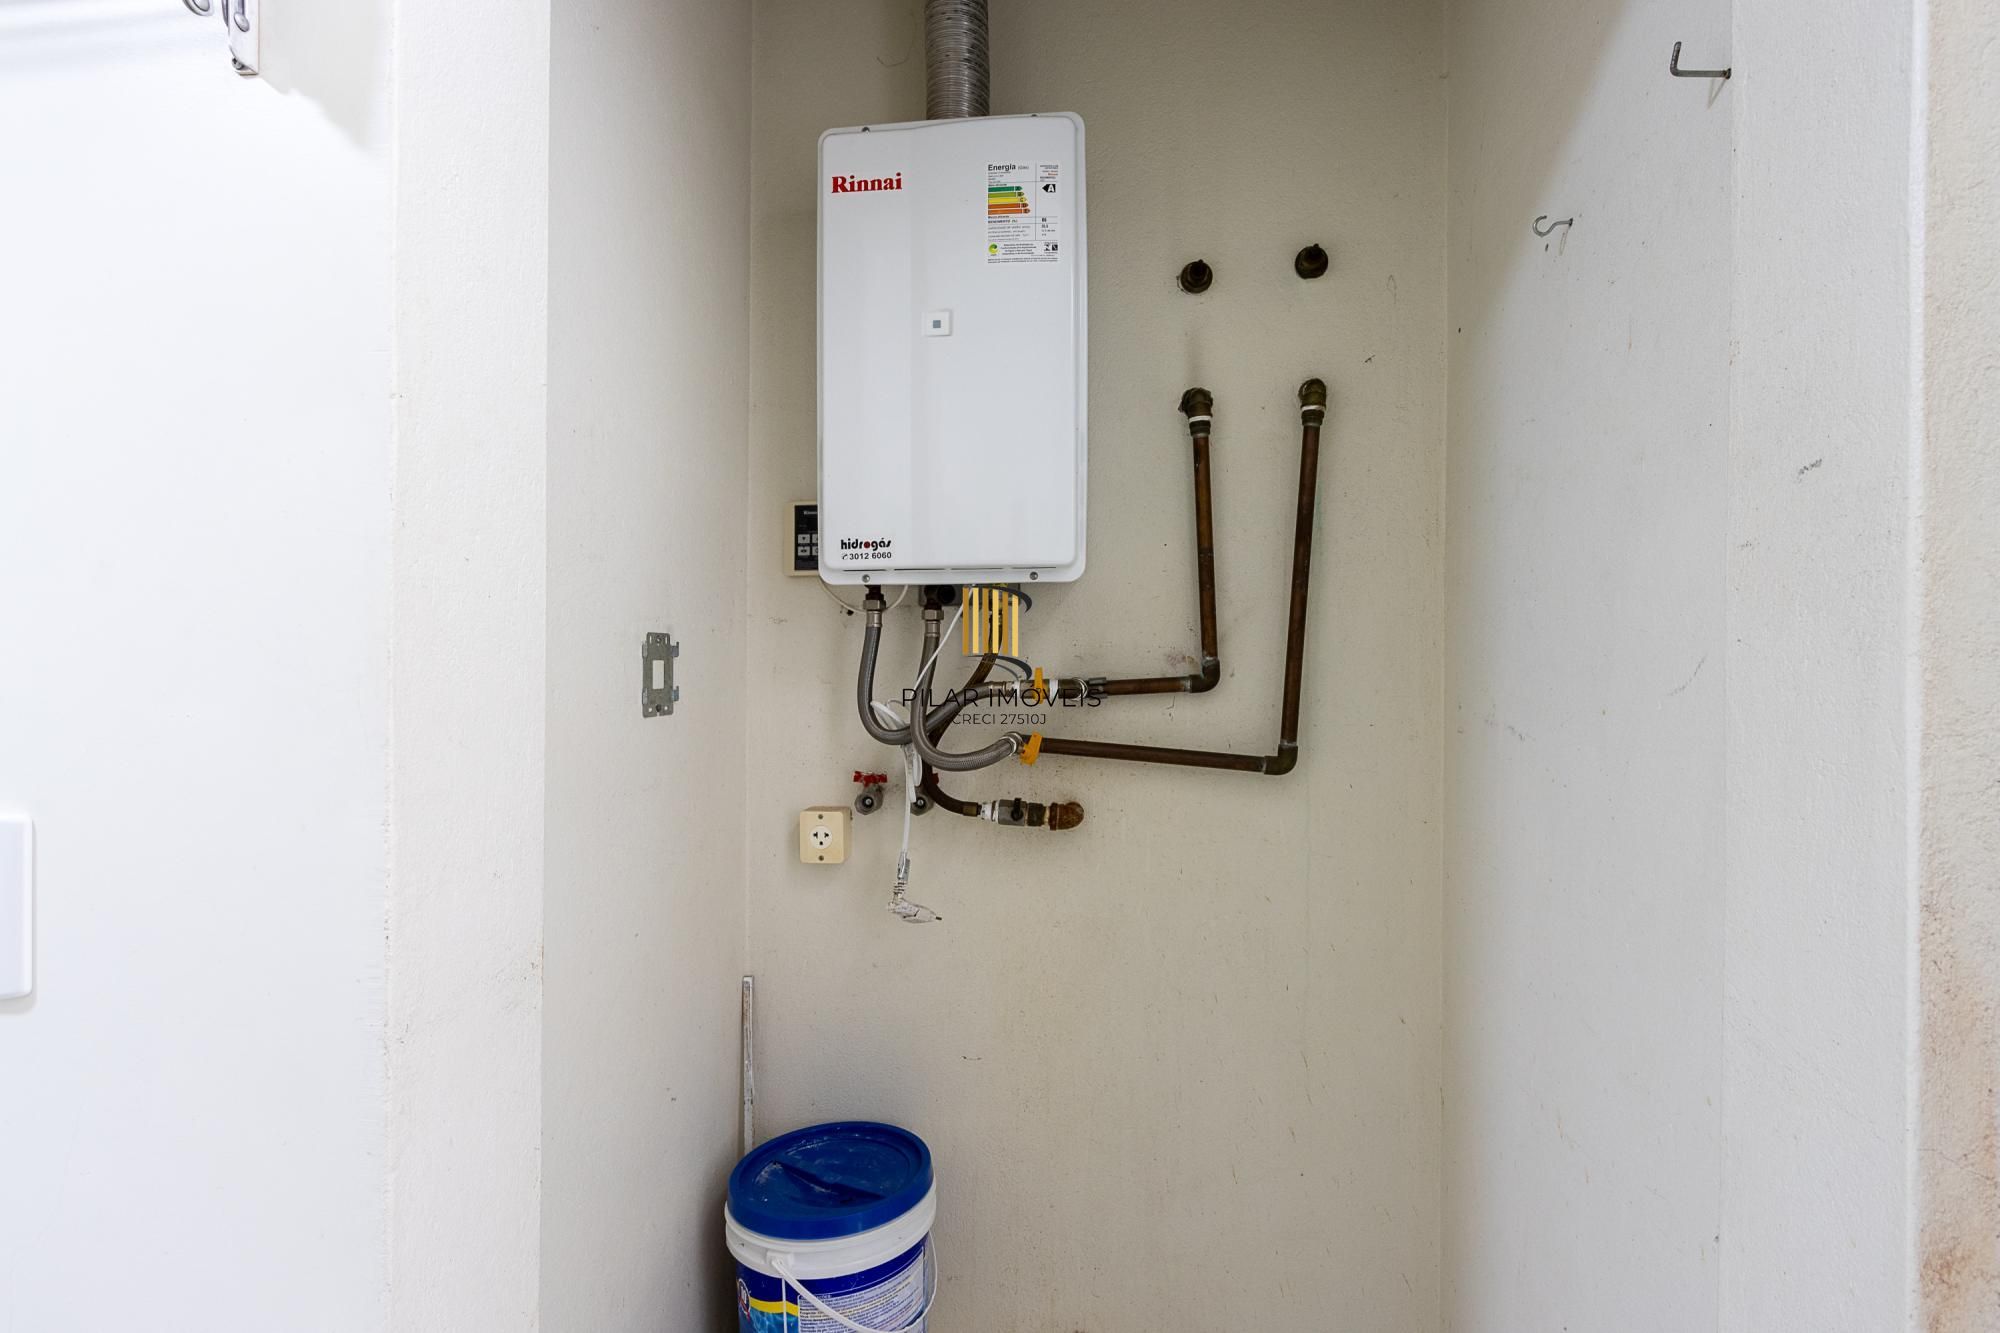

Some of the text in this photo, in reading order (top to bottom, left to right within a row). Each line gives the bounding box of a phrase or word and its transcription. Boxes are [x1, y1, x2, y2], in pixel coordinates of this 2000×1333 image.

[832, 172, 902, 193] Rinnai
[840, 538, 891, 551] hidrogás
[849, 551, 892, 560] 3012 6060
